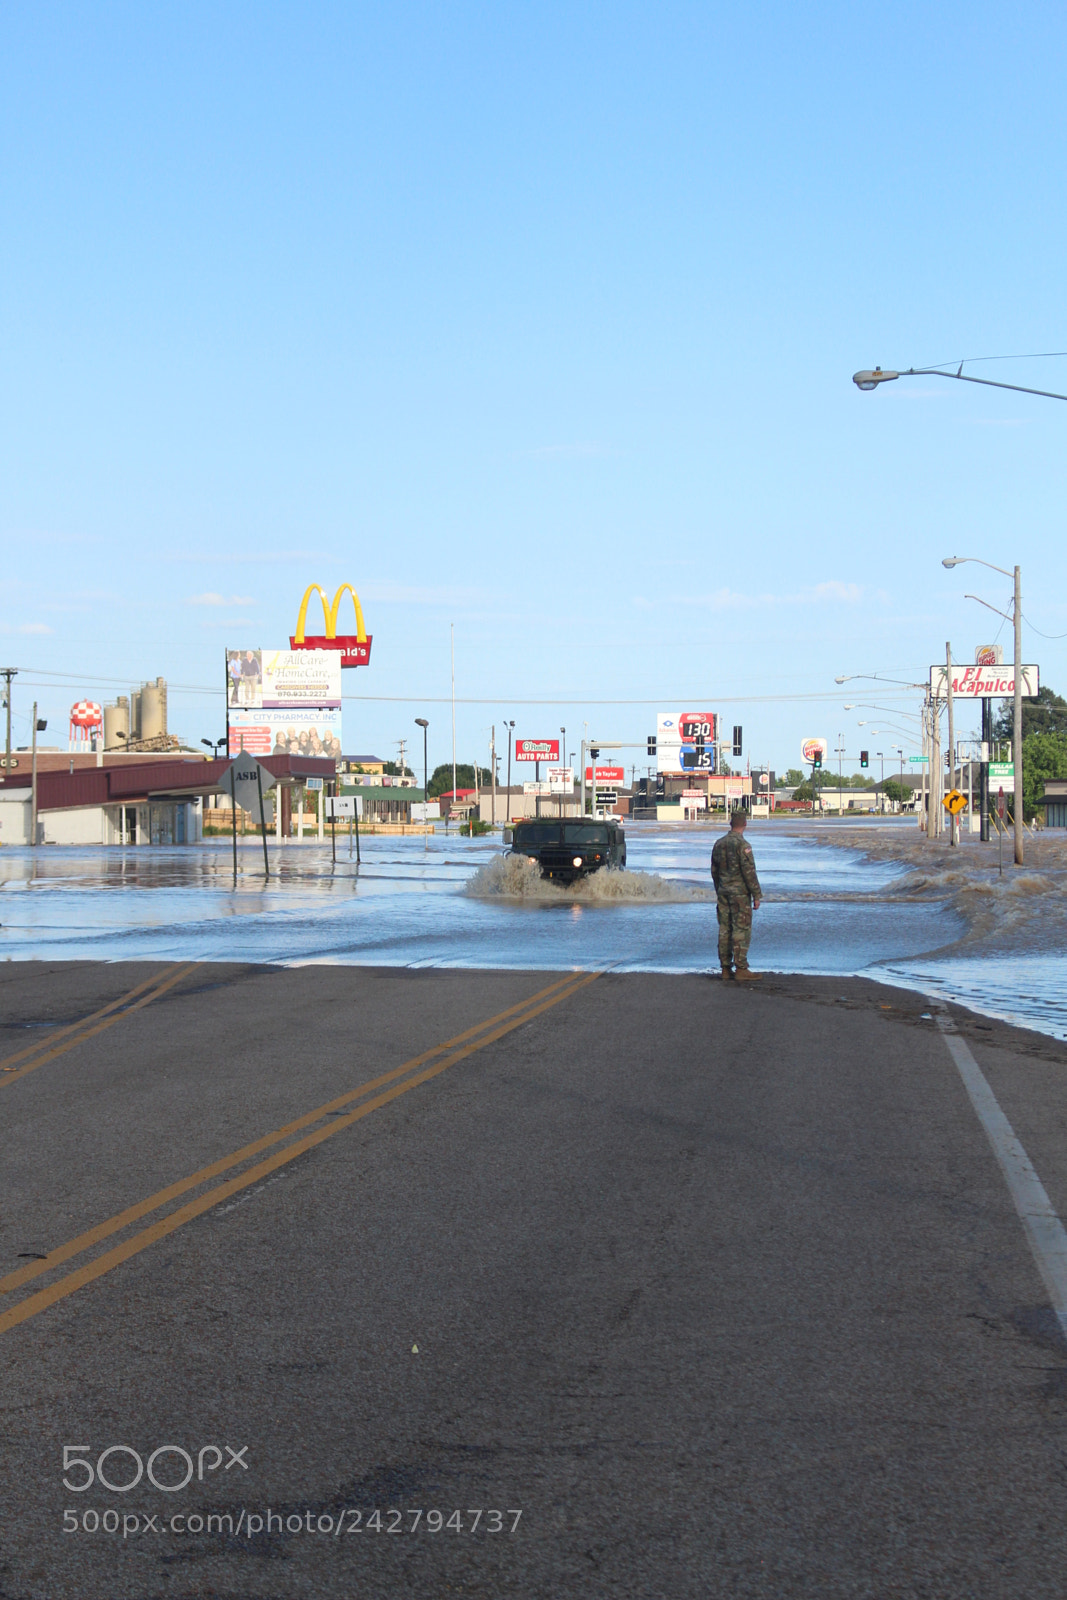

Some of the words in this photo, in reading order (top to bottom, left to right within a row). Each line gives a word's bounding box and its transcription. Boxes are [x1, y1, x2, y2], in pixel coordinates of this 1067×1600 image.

[963, 667, 983, 681] El
[951, 678, 1015, 696] Acapulco
[253, 713, 272, 721] CITY
[322, 713, 337, 721] INC
[688, 722, 711, 736] 130
[517, 752, 535, 760] AUTO
[536, 752, 558, 760] PARTS
[697, 752, 711, 766] 15
[236, 771, 257, 781] ASB
[603, 770, 618, 779] Taylor
